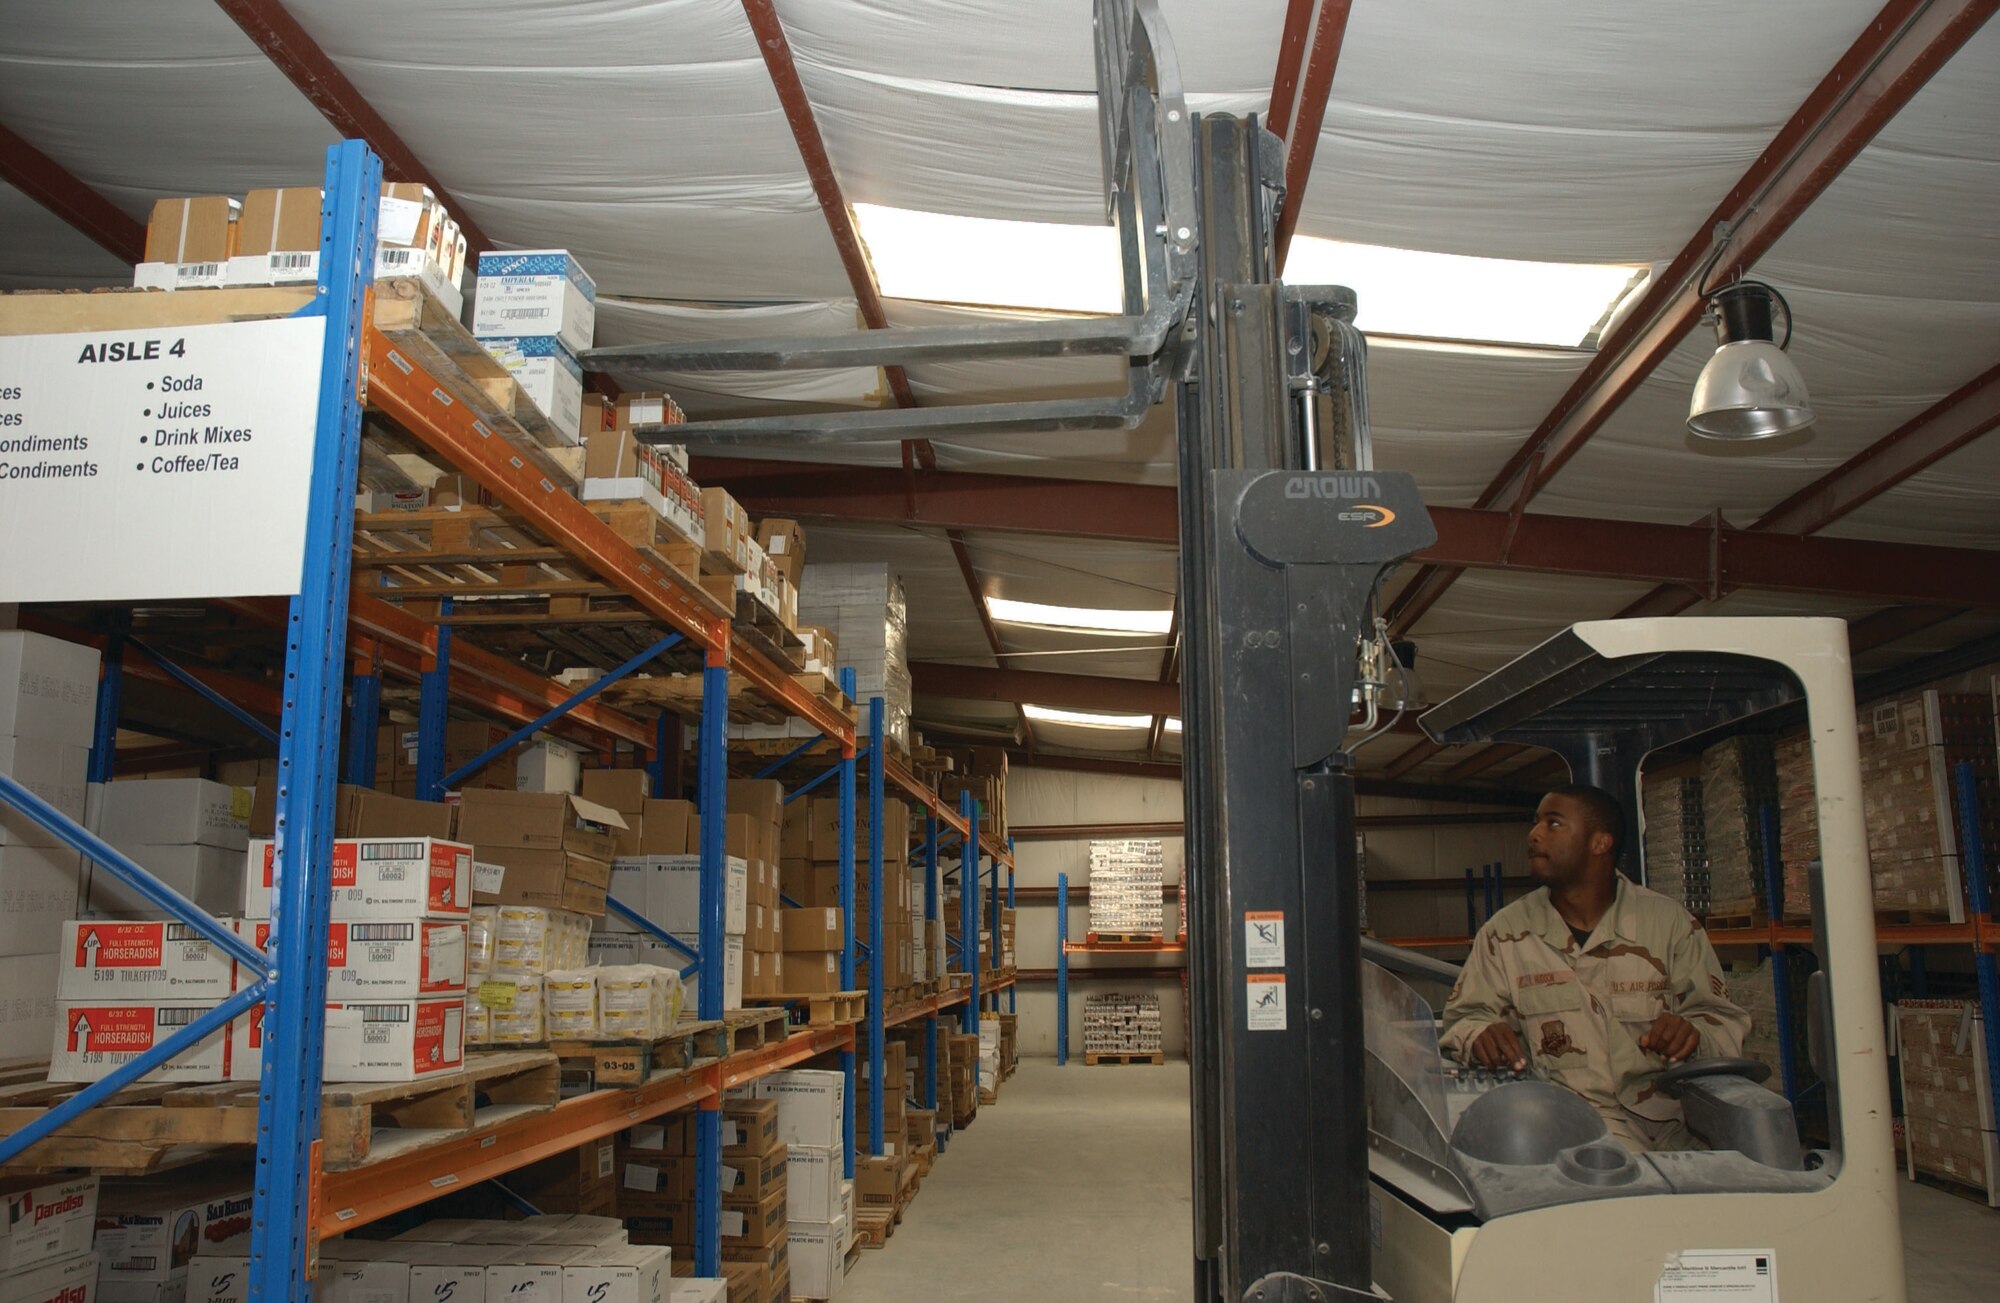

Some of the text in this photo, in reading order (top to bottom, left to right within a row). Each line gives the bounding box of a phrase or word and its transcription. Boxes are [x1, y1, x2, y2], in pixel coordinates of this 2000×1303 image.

[502, 256, 527, 275] SYSCO
[78, 338, 186, 363] AISLE 4
[161, 374, 203, 392] Soda
[158, 402, 211, 419] Juices
[0, 434, 88, 452] ondiments
[154, 426, 252, 446] Drink Mixes
[0, 461, 98, 480] Condiments
[152, 453, 239, 474] Coffee/Tea
[1285, 477, 1380, 498] CROWN
[1338, 512, 1376, 521] ESR
[103, 948, 159, 960] HORSERADISH
[94, 970, 114, 981] 5199
[1630, 982, 1644, 991] AIR
[94, 1032, 150, 1044] HORSERADISH
[83, 1052, 103, 1064] 5199
[604, 1062, 635, 1070] 03-05
[34, 1194, 84, 1226] Paradiso
